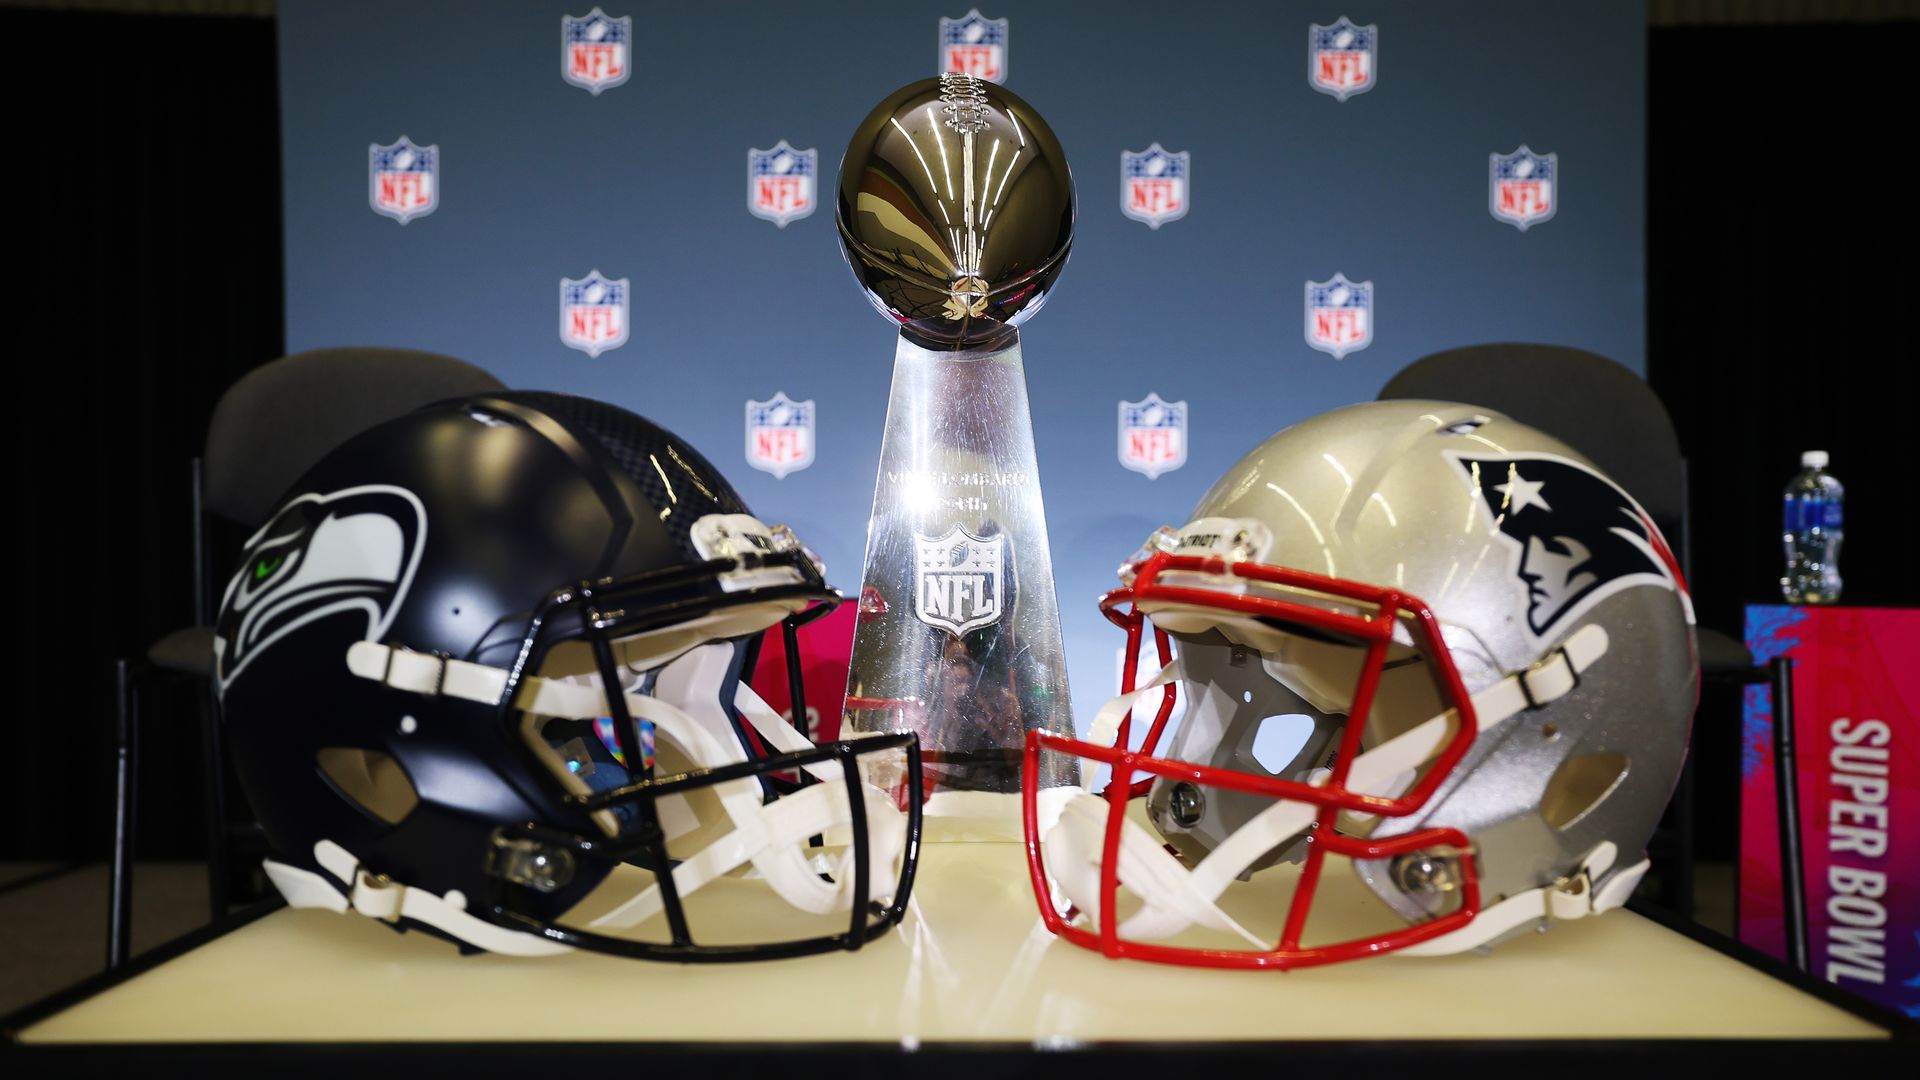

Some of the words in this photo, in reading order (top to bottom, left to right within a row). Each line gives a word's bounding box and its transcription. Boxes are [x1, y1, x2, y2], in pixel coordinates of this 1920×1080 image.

[571, 46, 624, 79] NFL
[949, 47, 1000, 77] NFL
[1318, 53, 1368, 86] NFL
[379, 175, 430, 207] NFL
[756, 179, 808, 211] NFL
[1130, 181, 1181, 213] NFL
[1499, 183, 1549, 215] NFL
[570, 309, 621, 341] NFL
[1315, 312, 1365, 344] NFL
[756, 431, 806, 463] NFL
[1129, 432, 1178, 463] NFL
[924, 574, 994, 623] NFL
[1827, 717, 1892, 859] SUPER
[1826, 864, 1888, 985] BOWL
